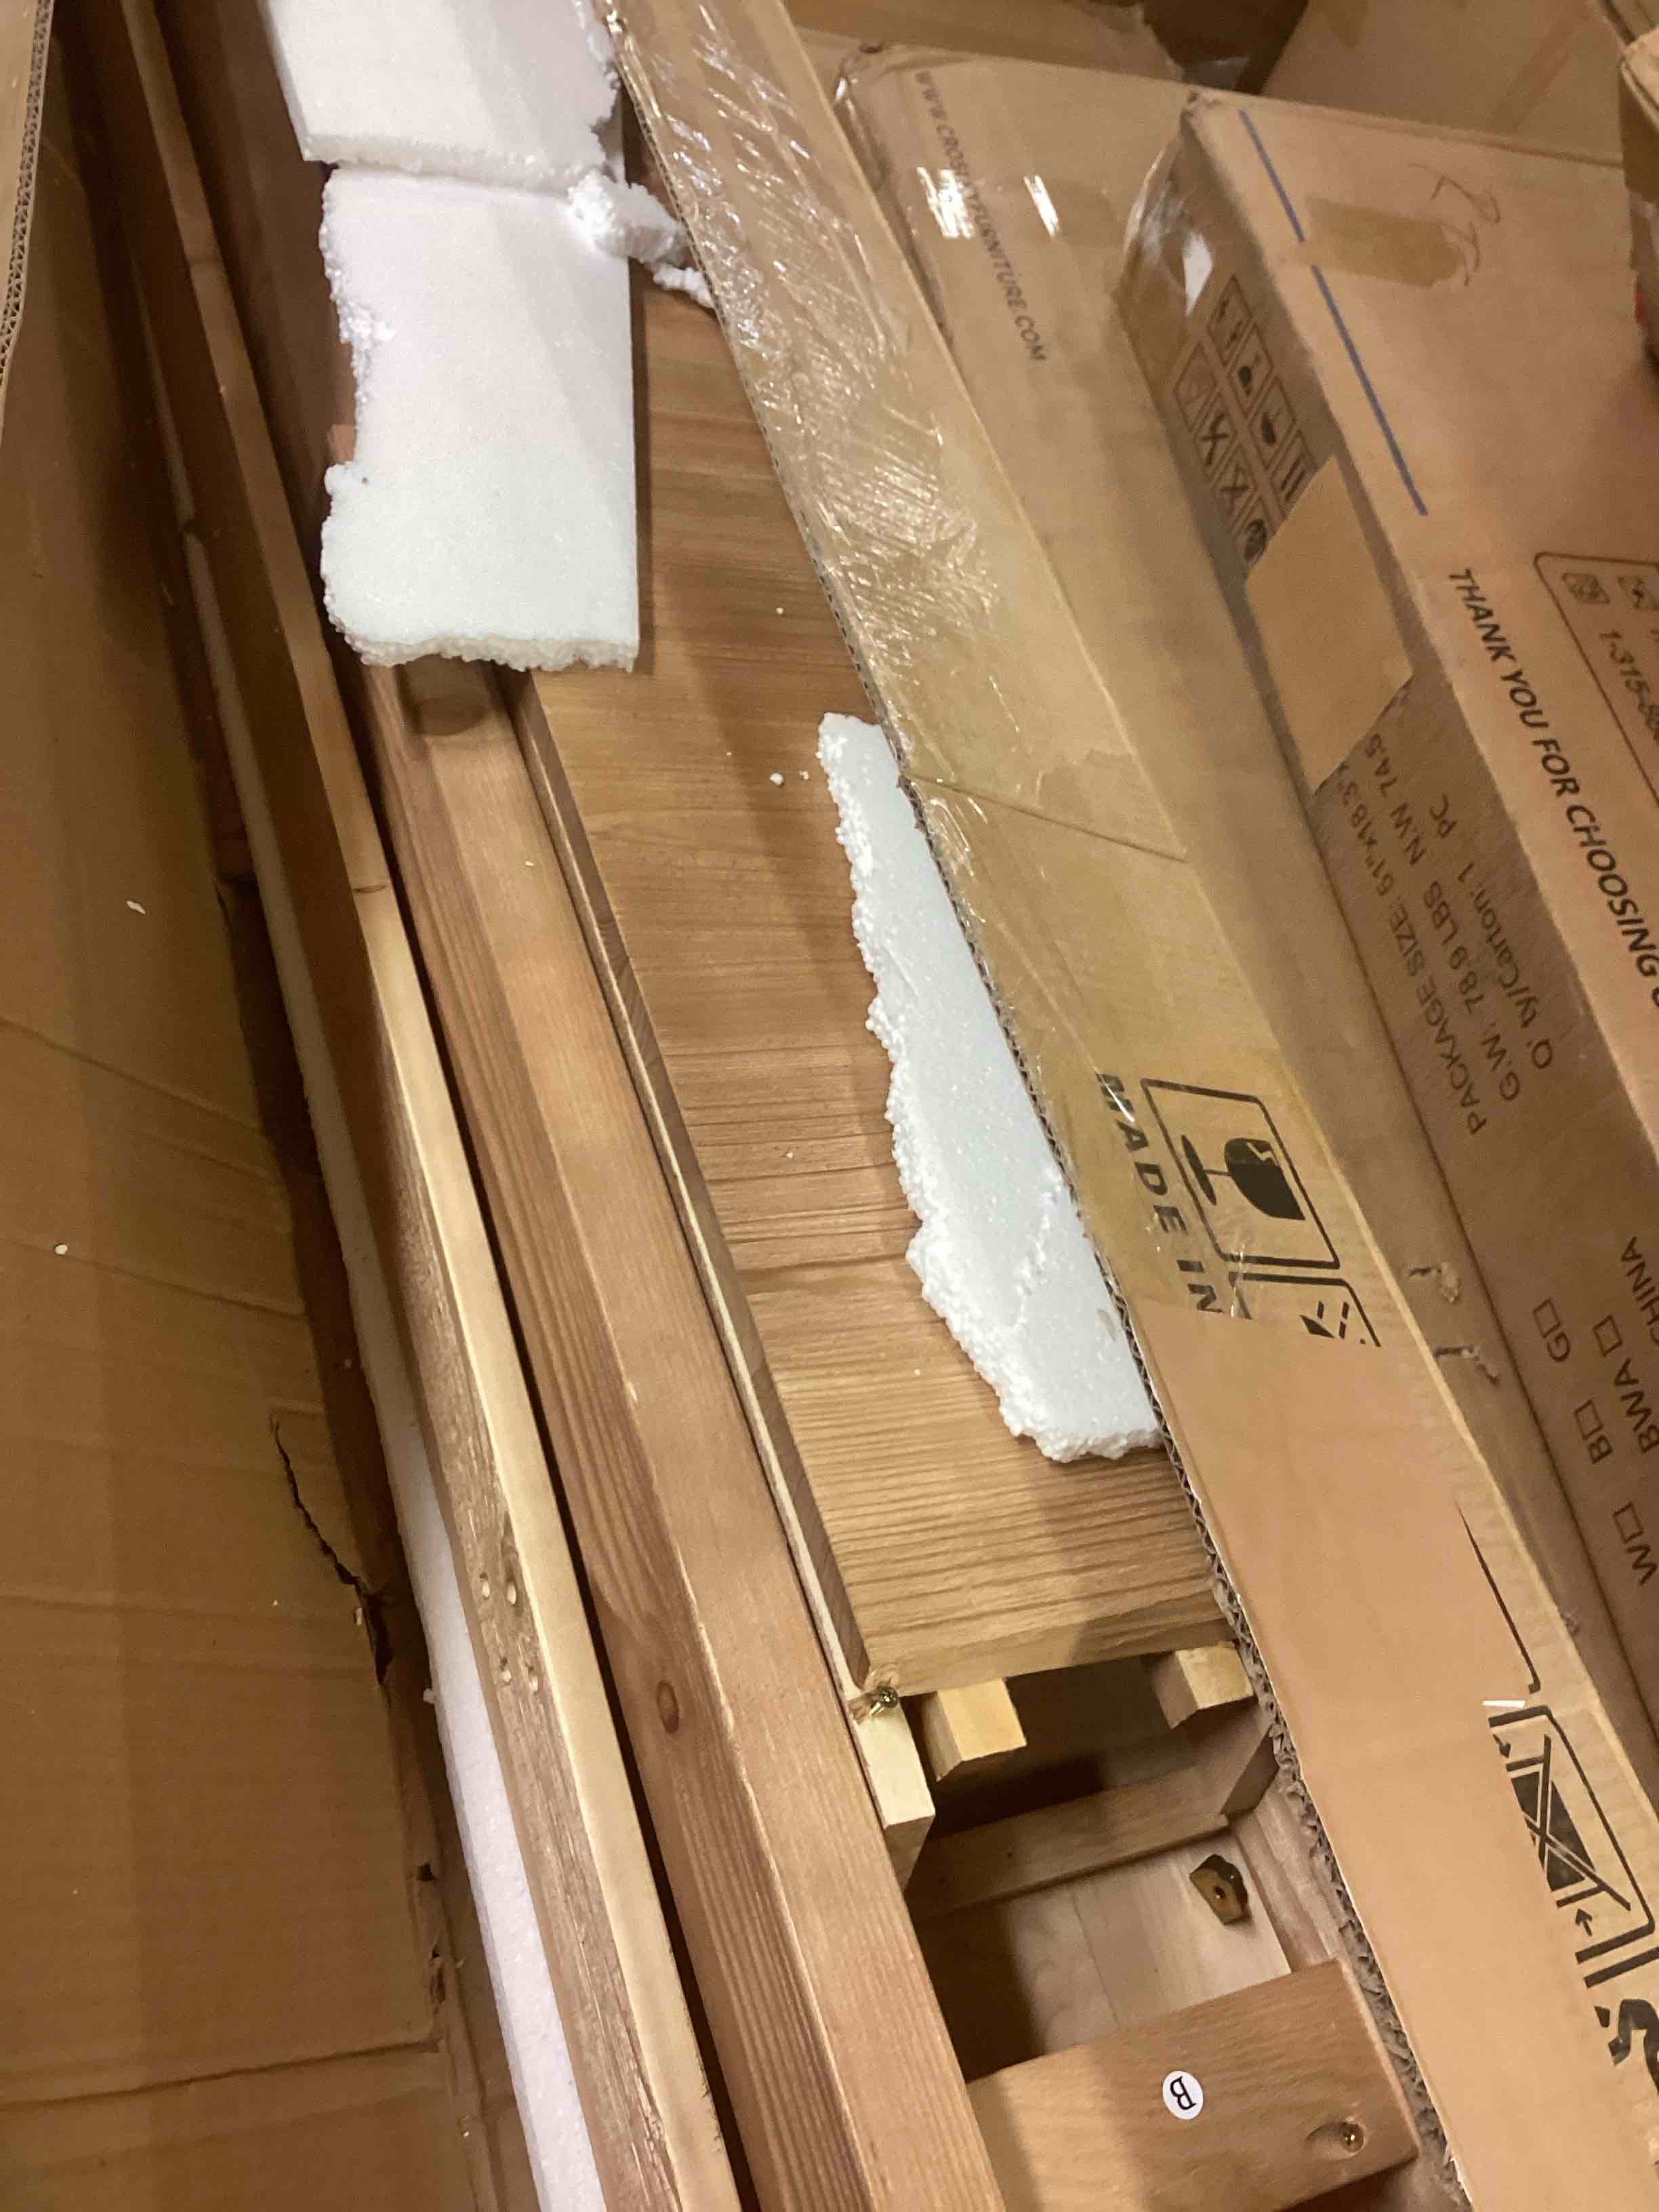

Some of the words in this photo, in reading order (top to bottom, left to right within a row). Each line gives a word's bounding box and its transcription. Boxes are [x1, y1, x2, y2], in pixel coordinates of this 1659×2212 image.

[1449, 569, 1517, 662] THANK
[1500, 670, 1550, 729] YOU
[1532, 738, 1580, 798] FOR
[1565, 804, 1659, 978] CHOOSING
[1429, 791, 1457, 839] PC
[1457, 861, 1475, 882] 1
[1424, 880, 1460, 947] LBS
[1416, 974, 1488, 1135] PACKAGE
[1095, 1073, 1187, 1237] MADE
[1176, 1259, 1223, 1313] IN
[1547, 1331, 1572, 1362] G
[1614, 1355, 1659, 1454] BWA
[1587, 1434, 1614, 1465] B
[1627, 1542, 1658, 1586] W
[1170, 2076, 1197, 2110] B
